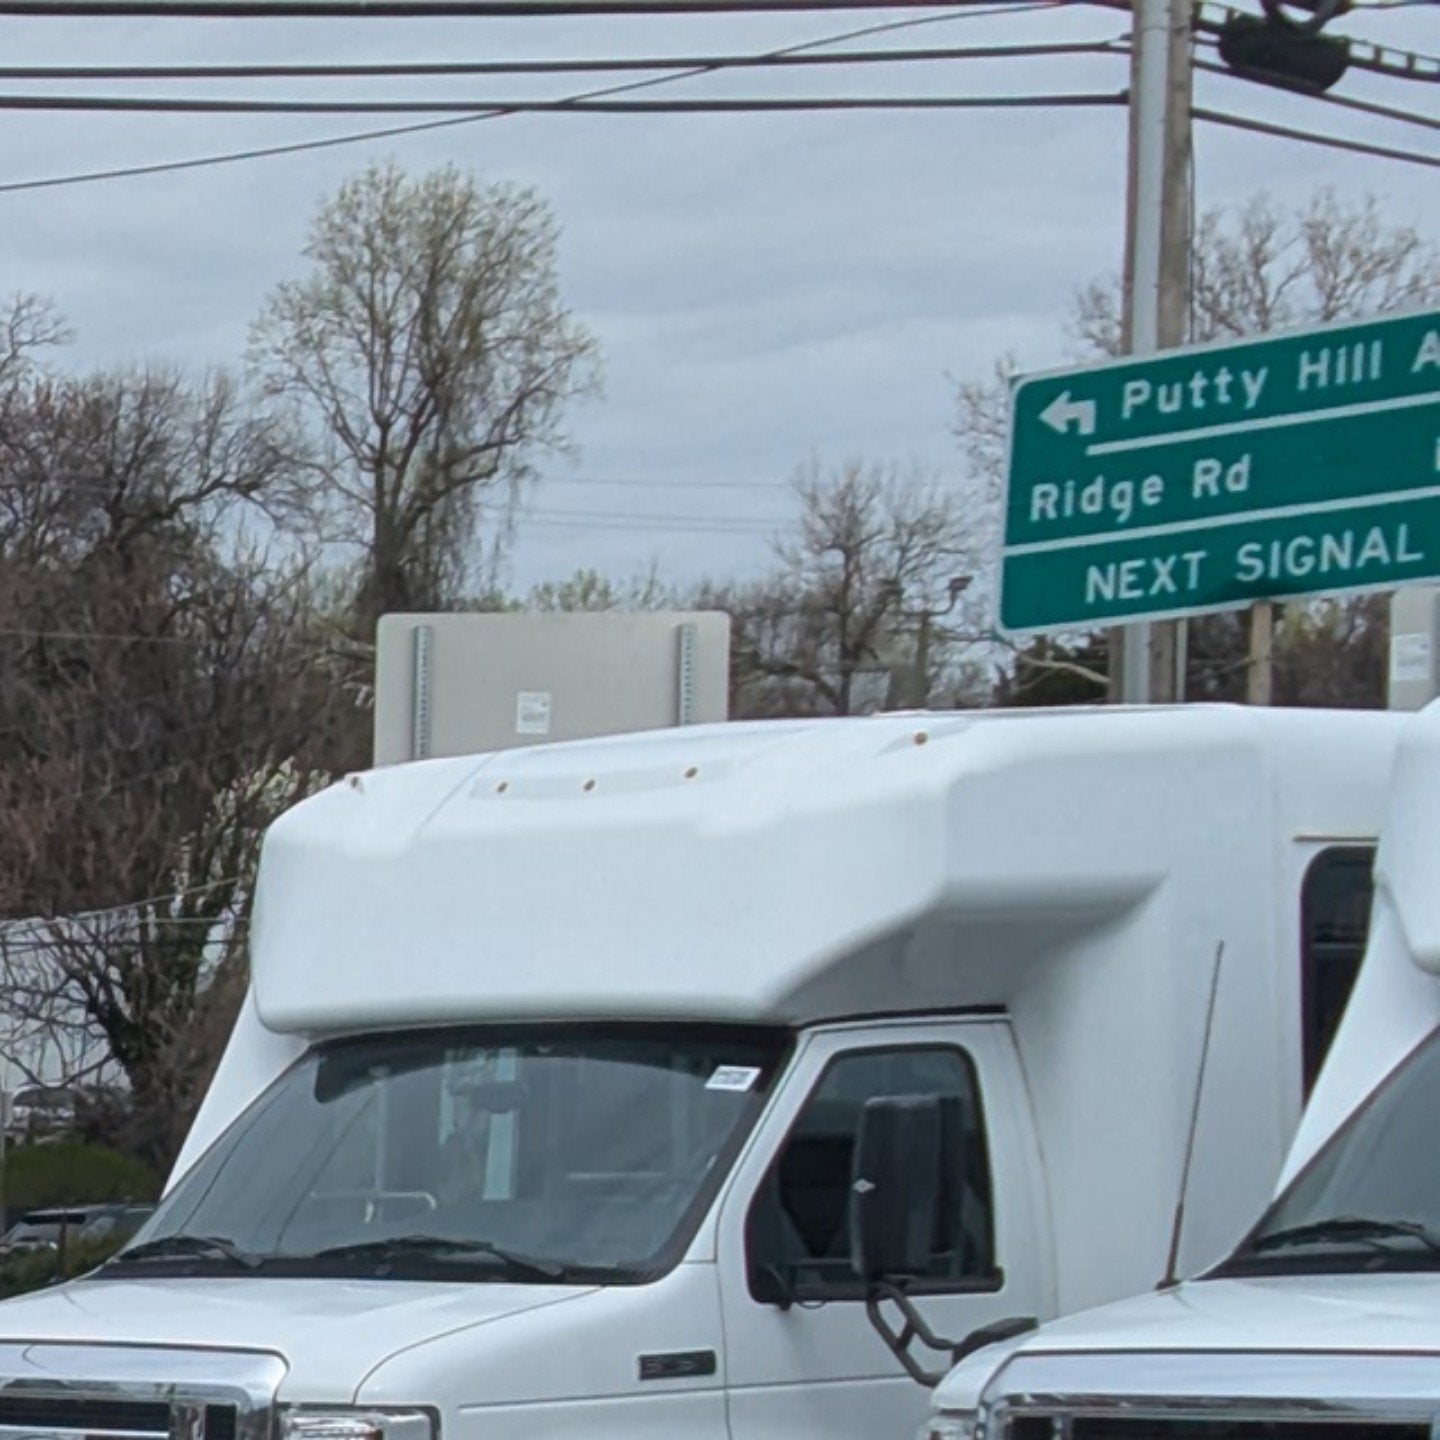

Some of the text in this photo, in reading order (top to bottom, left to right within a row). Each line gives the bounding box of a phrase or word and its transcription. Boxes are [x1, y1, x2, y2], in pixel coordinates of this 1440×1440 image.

[1121, 367, 1269, 420] Putty
[1297, 338, 1384, 391] Hill
[1030, 454, 1252, 524] Ridge Rd
[1085, 523, 1424, 604] NEXT SIGNAL
